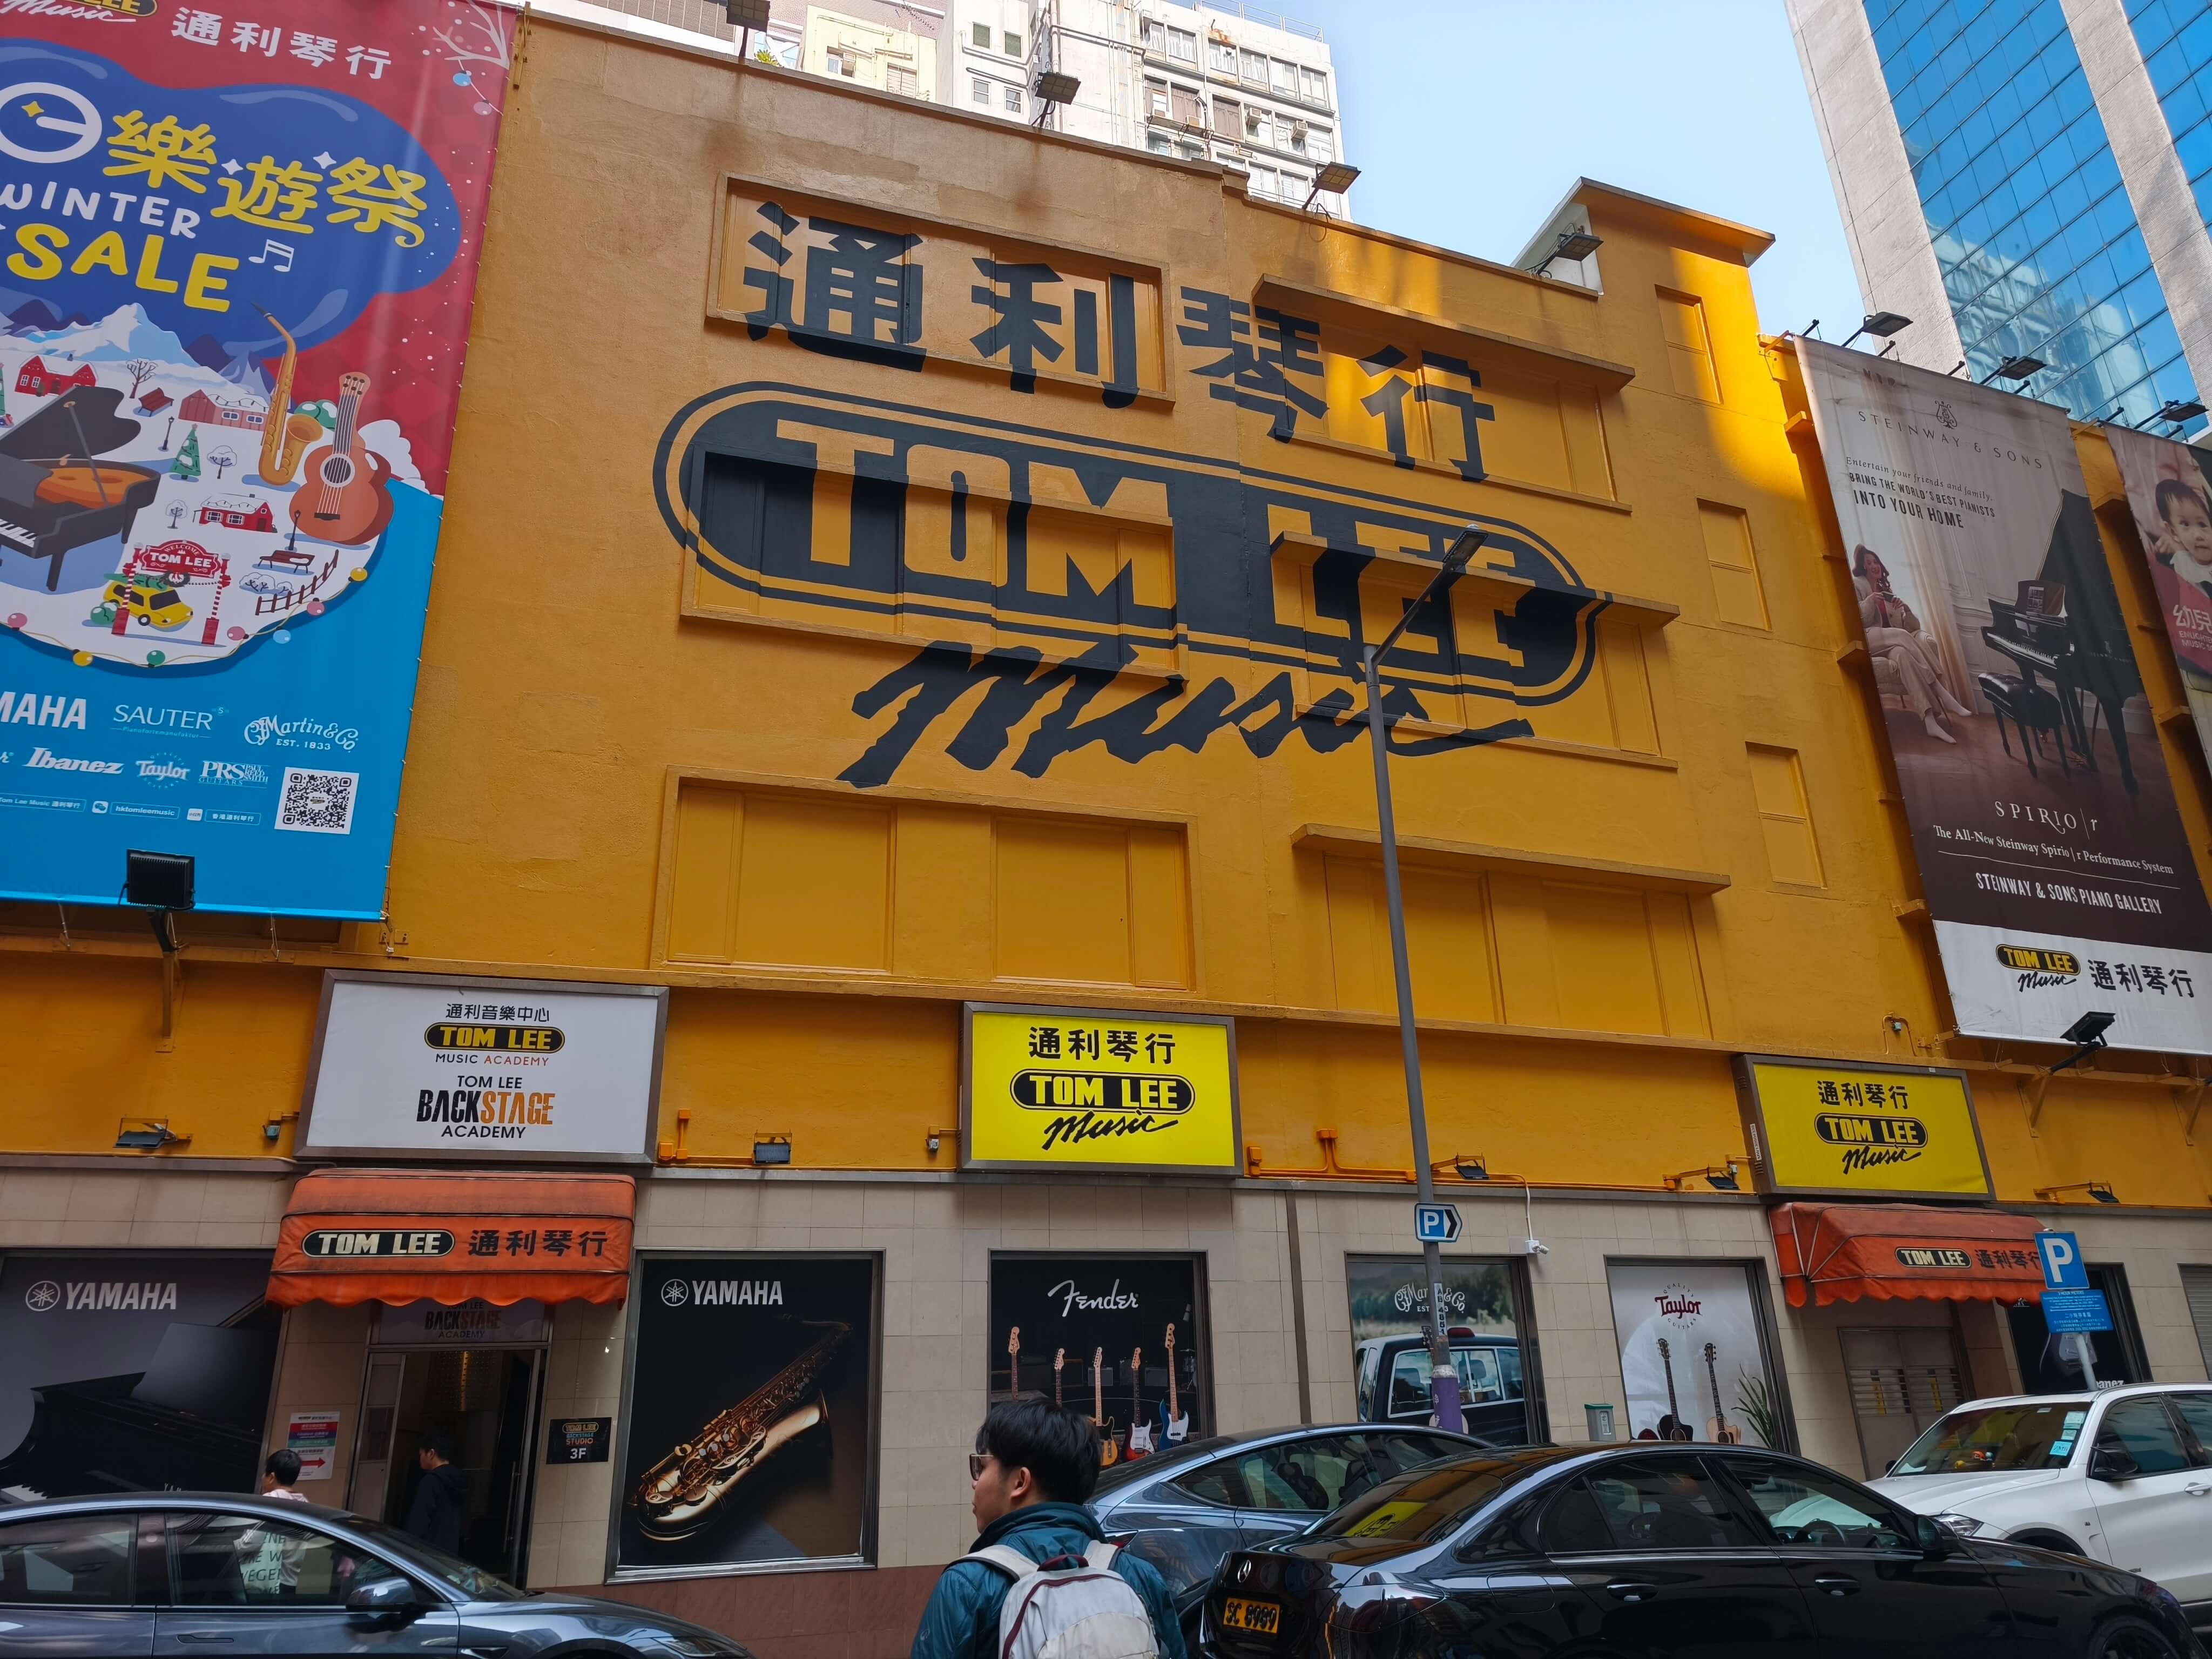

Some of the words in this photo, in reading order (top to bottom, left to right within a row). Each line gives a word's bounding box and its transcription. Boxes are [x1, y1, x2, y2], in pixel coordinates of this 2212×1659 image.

[171, 6, 393, 79] 通利琴行
[0, 181, 200, 239] WINTER
[6, 223, 239, 312] SALE
[744, 200, 1496, 483] 通利琴行
[1858, 412, 1959, 447] STEINWAY
[1974, 443, 1981, 453] &
[1994, 448, 2042, 469] SONS
[1846, 457, 1889, 473] Entertain
[1892, 468, 1911, 477] your
[1914, 474, 1943, 487] friends
[1947, 483, 1961, 492] and
[1964, 487, 1992, 501] family.
[1850, 473, 1877, 486] BRING
[1879, 478, 1896, 491] THE
[1898, 483, 1934, 501] WORLD'S
[1936, 494, 1956, 507] BEST
[1960, 499, 1994, 517] PIANISTS
[1853, 490, 1885, 509] INTO
[1890, 497, 1923, 520] YOUR
[1927, 507, 1964, 528] HOME
[164, 544, 200, 556] WELCOME
[777, 419, 1176, 609] TOM
[1267, 503, 1534, 667] LEE
[150, 552, 181, 564] TOM
[185, 556, 212, 568] LEE
[113, 704, 213, 730] SAUTER
[836, 641, 1534, 788] Music
[123, 726, 199, 738] Pianofortemanufaktur
[276, 738, 300, 747] EST.
[304, 741, 331, 750] 1833
[23, 747, 125, 774] Ibanez
[136, 760, 191, 781] Taylor
[200, 760, 245, 779] PRS
[199, 777, 243, 785] GUITARS
[116, 805, 175, 816] hktomleemusic
[1995, 801, 2076, 834] SPIRIO
[1933, 825, 1952, 839] The
[1955, 830, 1994, 845] All-New
[1996, 837, 2039, 855] Steinway
[2083, 850, 2141, 869] Performance
[2142, 860, 2174, 875] System
[1975, 872, 2032, 897] STEINWAY
[2035, 882, 2046, 899] &
[2047, 884, 2079, 903] SONS
[2079, 888, 2113, 908] PIANO
[2115, 894, 2163, 914] GALLERY
[2004, 947, 2040, 968] TOM
[2044, 953, 2074, 973] LEE
[2018, 970, 2077, 992] Music
[2087, 959, 2195, 998] 通利琴行
[446, 1003, 550, 1022] 通利音樂中心
[440, 1026, 495, 1047] TOM
[508, 1028, 551, 1050] LEE
[1028, 1026, 1176, 1064] 通利琴行
[436, 1053, 478, 1064] MUSIC
[485, 1055, 549, 1067] ACADEMY
[457, 1075, 493, 1088] TOM
[498, 1077, 523, 1089] LEE
[1029, 1075, 1104, 1106] TOM
[1121, 1079, 1178, 1109] LEE
[1817, 1080, 1908, 1110] 通利琴行
[416, 1089, 555, 1125] BACKSTAGE
[441, 1125, 527, 1139] ACADEMY
[1042, 1109, 1178, 1150] Music
[1825, 1117, 1873, 1142] TOM
[1882, 1120, 1919, 1143] LEE
[1842, 1144, 1921, 1175] Music
[1424, 1211, 1439, 1234] P
[319, 1233, 379, 1255] TOM
[392, 1233, 441, 1254] LEE
[468, 1230, 608, 1257] 通利琴行
[1901, 1250, 1936, 1266] TOM
[1941, 1250, 1966, 1266] LEE
[2043, 1238, 2073, 1283] P
[66, 1283, 177, 1310] YAMAHA
[692, 1280, 783, 1305] YAMAHA
[1048, 1279, 1139, 1317] Fender
[1655, 1294, 1702, 1319] Taylor
[438, 1331, 485, 1339] ACADEMY
[570, 1448, 586, 1459] 3F
[1226, 1602, 1242, 1625] SC
